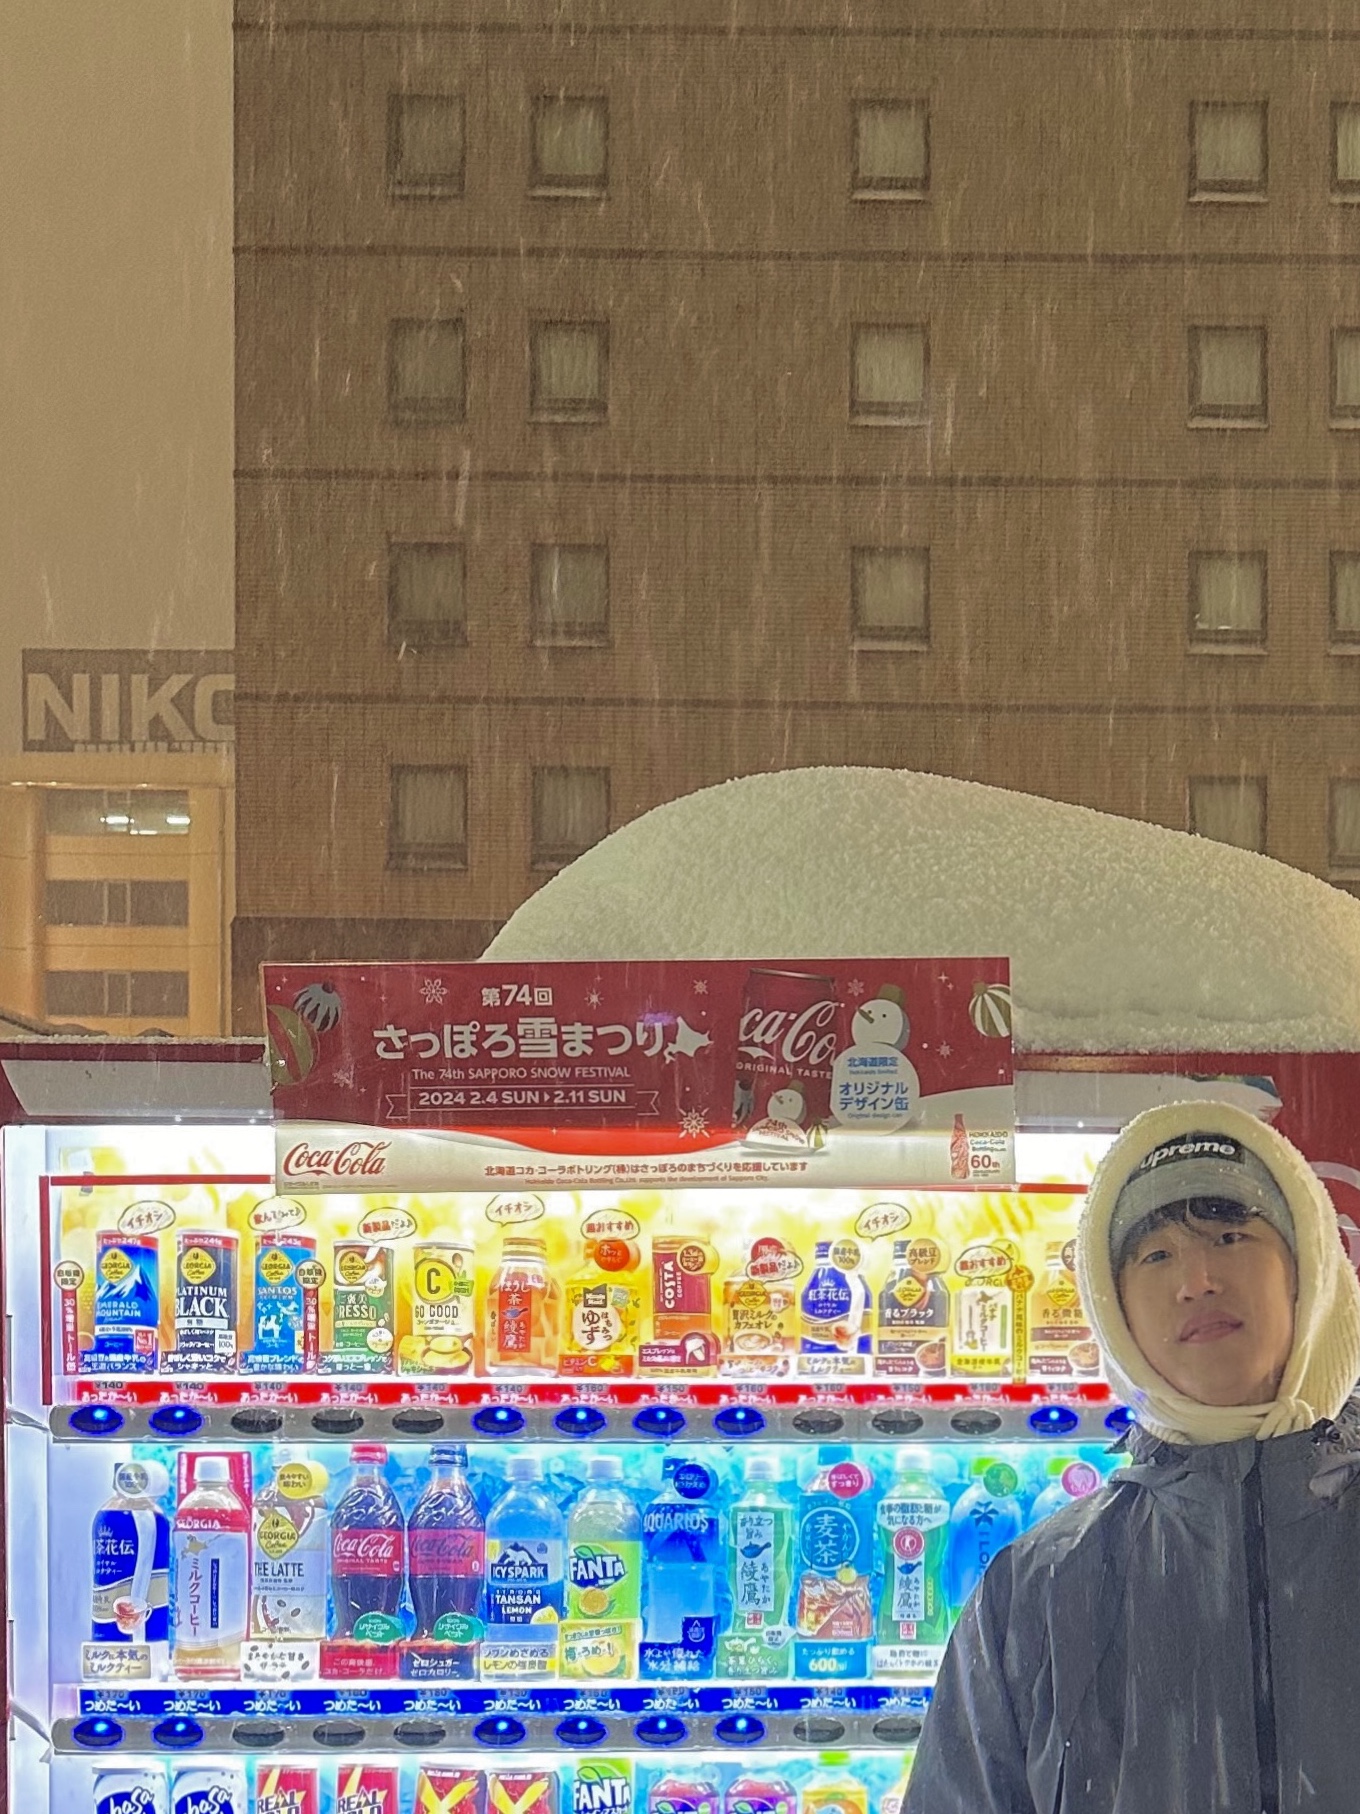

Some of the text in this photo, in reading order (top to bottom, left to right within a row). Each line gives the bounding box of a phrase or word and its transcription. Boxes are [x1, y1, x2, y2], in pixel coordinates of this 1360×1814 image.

[481, 985, 553, 1007] 第74回
[373, 1017, 665, 1058] さっぽろ雪まつり
[412, 1067, 630, 1080] The 74th SAPPORO SNOW FESTIVAL
[839, 1082, 908, 1095] オリジナル
[419, 1090, 626, 1105] 2024 2.4 SUN 2.11 SUN
[839, 1097, 909, 1111] デザイン缶
[283, 1141, 392, 1176] Coca-Cola
[1140, 1141, 1236, 1169] upreme
[663, 1260, 675, 1309] COSTA
[430, 1304, 458, 1318] GOOD
[177, 1519, 221, 1529] GEORGIA
[816, 1515, 839, 1565] 麦茶
[272, 1562, 304, 1577] LATTE
[509, 1566, 545, 1579] SPARK
[570, 1555, 625, 1579] FANTA
[741, 1563, 761, 1606] 綾鷹
[495, 1595, 541, 1604] TANSAN
[501, 1606, 532, 1615] LEMON
